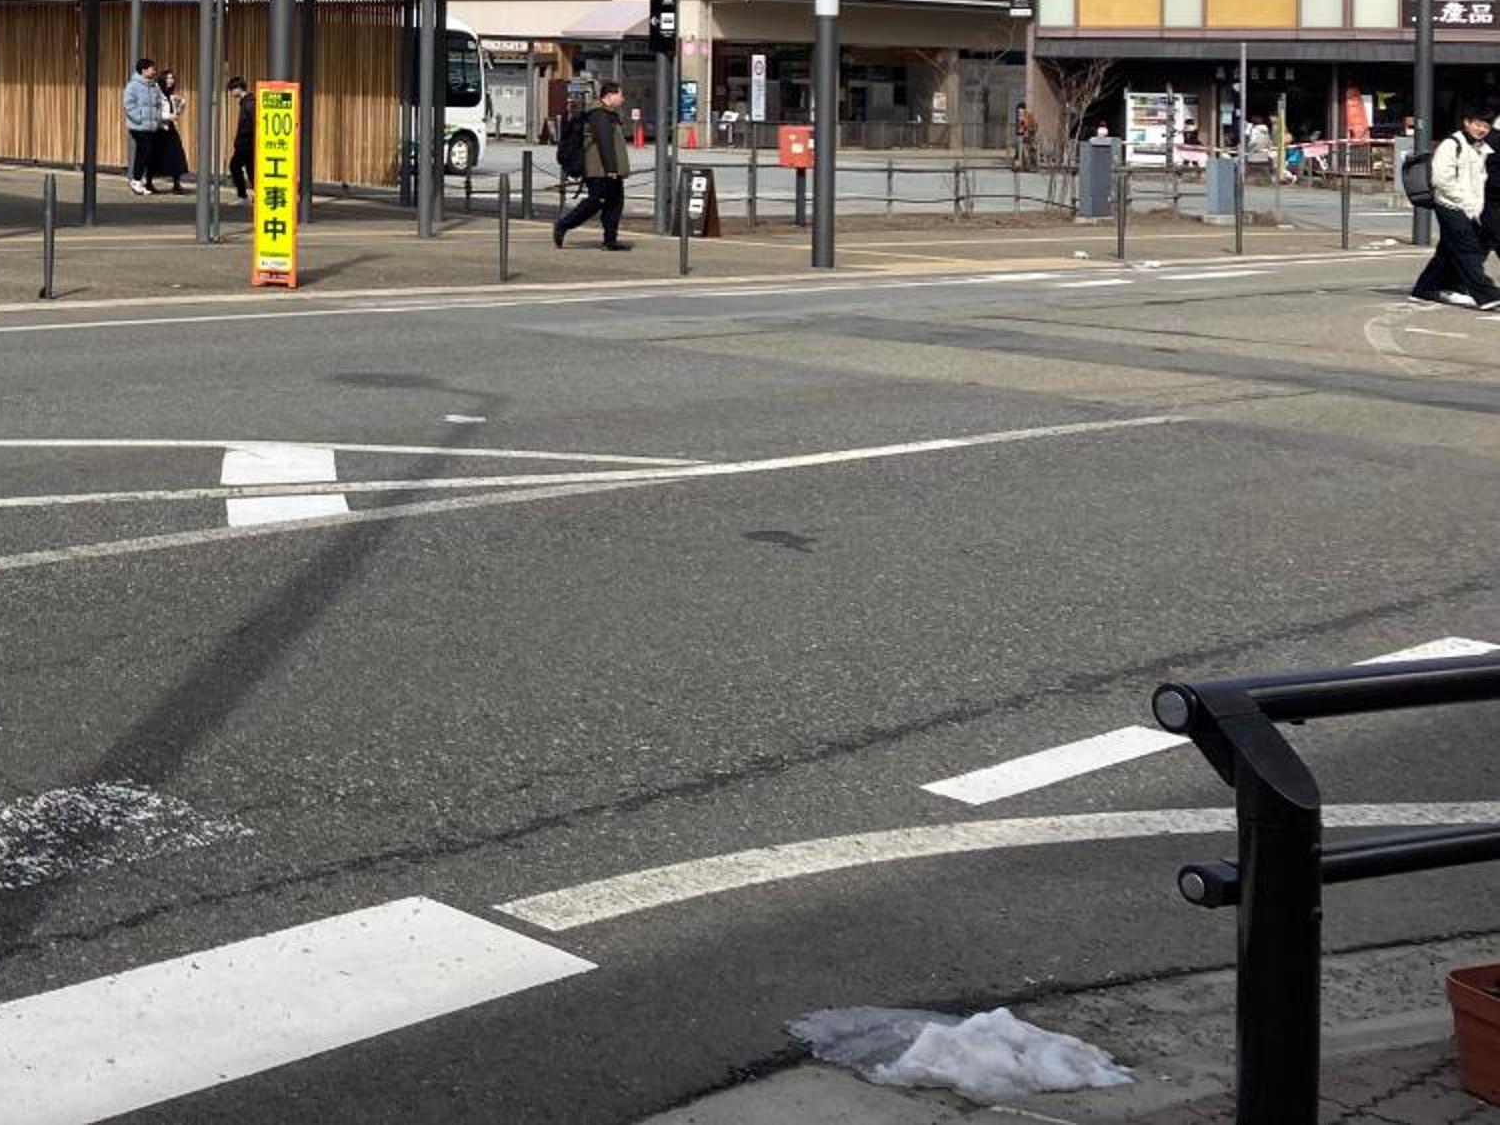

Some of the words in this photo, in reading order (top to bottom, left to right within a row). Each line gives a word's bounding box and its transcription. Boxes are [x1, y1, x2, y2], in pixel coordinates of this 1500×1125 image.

[1411, 2, 1493, 23] 産品
[262, 113, 293, 136] 100
[263, 157, 288, 241] 工事中
